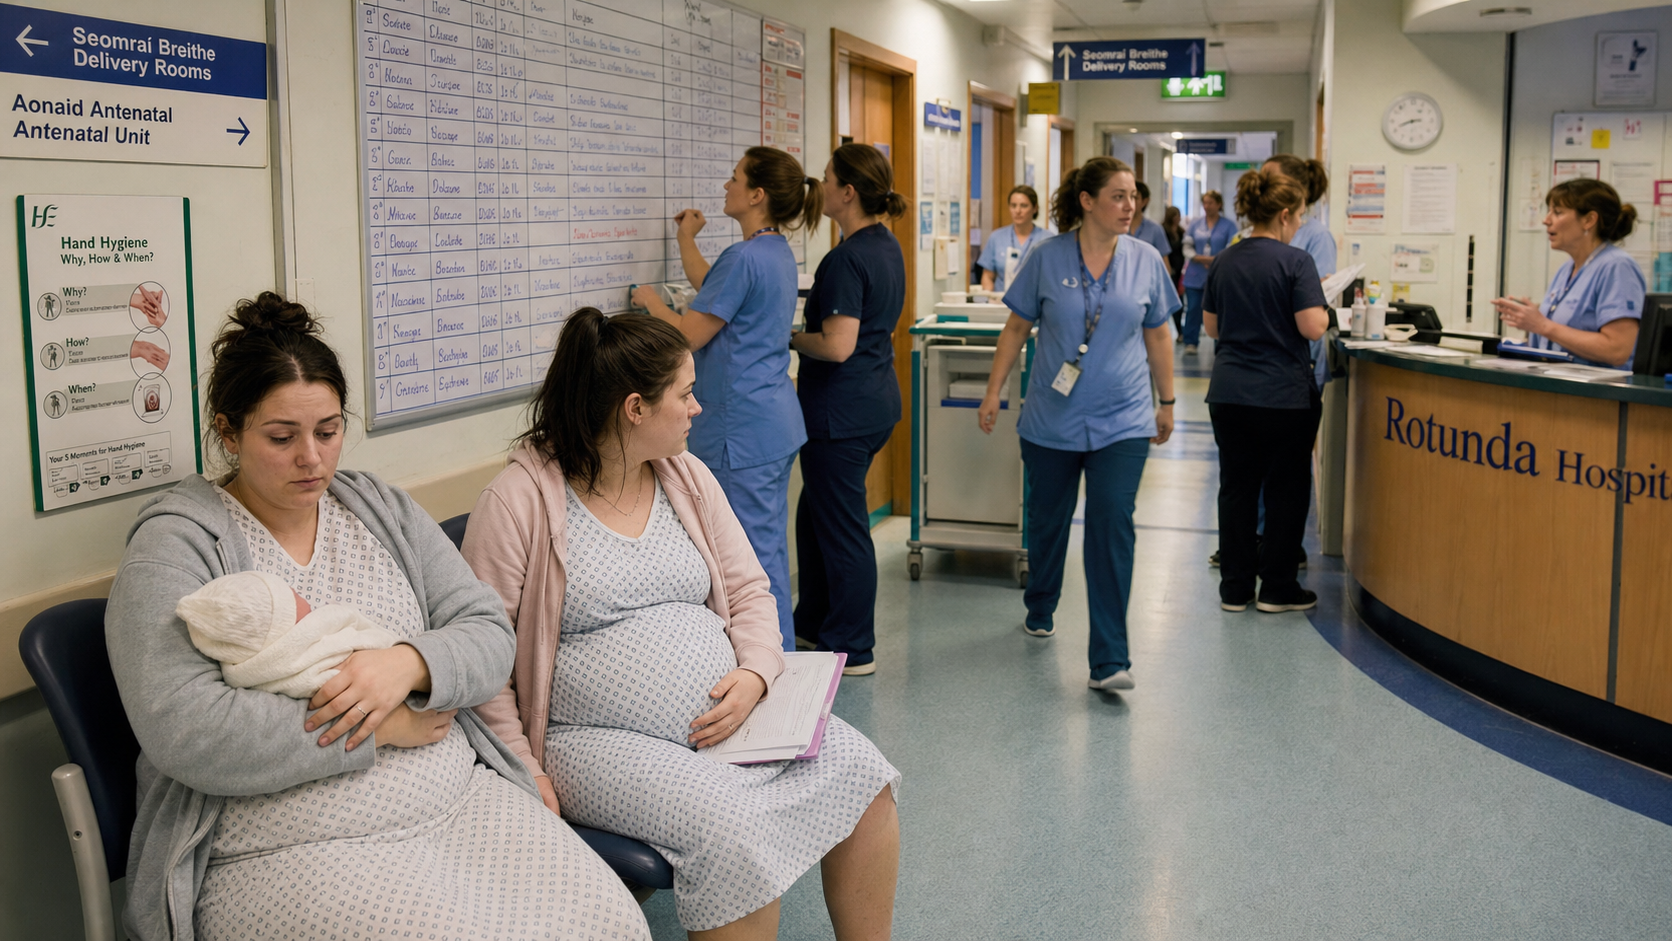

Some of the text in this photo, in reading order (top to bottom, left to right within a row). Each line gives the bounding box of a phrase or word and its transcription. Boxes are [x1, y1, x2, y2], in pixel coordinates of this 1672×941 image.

[72, 26, 216, 61] Seomraí Breithe
[1129, 48, 1169, 59] Breithe
[73, 48, 212, 81] Delivery Rooms
[1082, 59, 1167, 73] Delivery Rooms
[11, 93, 173, 123] Aonaid Antenatal
[13, 120, 151, 145] Antenatal Unit
[31, 204, 59, 229] HSE
[61, 236, 149, 251] Hand Hygiene
[60, 252, 154, 266] Why, How & When?
[62, 286, 87, 299] Why?
[66, 337, 89, 348] How?
[68, 382, 97, 394] When?
[49, 454, 63, 464] Your
[70, 449, 98, 460] Moments
[108, 444, 123, 453] Hand
[1384, 396, 1672, 505] Rotunda Hospit
